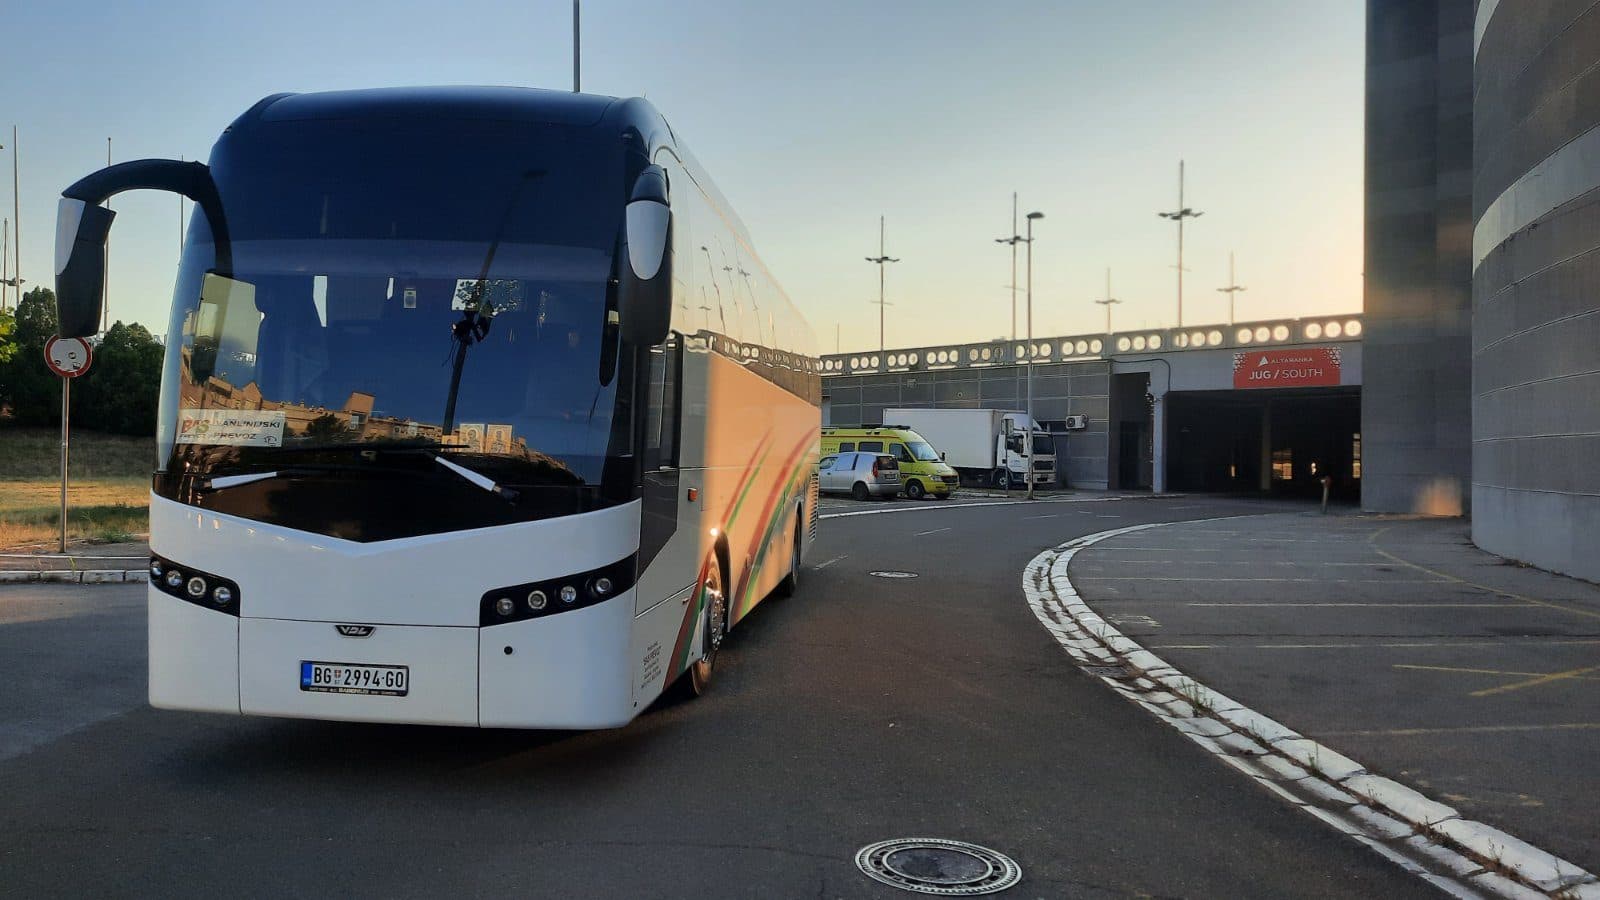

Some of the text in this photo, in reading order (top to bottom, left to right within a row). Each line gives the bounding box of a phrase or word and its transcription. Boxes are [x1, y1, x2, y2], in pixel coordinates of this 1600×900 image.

[1249, 370, 1272, 380] JUG
[1281, 368, 1323, 379] SOUTH
[314, 666, 332, 684] BG
